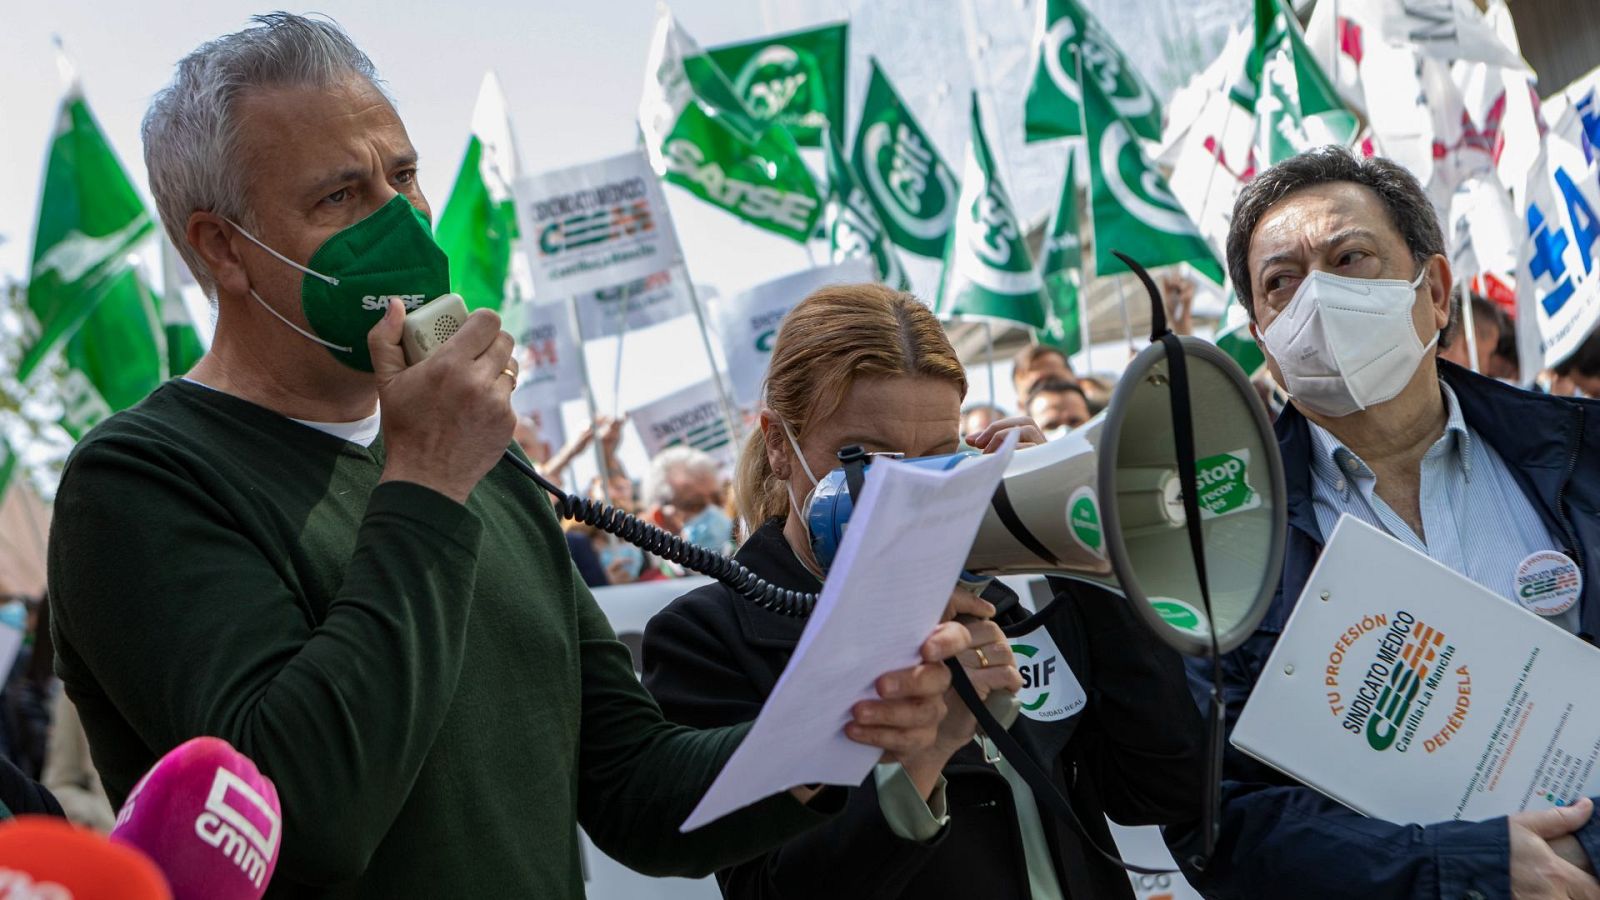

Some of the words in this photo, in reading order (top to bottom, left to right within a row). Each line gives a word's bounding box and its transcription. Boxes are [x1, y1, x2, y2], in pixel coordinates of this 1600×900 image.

[664, 139, 817, 231] SATSE
[1018, 656, 1056, 689] SIF
[1325, 613, 1387, 686] PROFESIÓN
[1342, 662, 1389, 734] SINDICATO
[1376, 610, 1415, 665] MÉDICO
[1366, 621, 1445, 751] CESM
[1327, 692, 1344, 716] TU
[1395, 690, 1434, 752] Castilla-La
[1425, 645, 1456, 690] Mancha
[1423, 664, 1471, 753] DEFIÉNDELA
[1476, 740, 1495, 771] Sindicato
[1502, 706, 1511, 716] de
[1507, 681, 1523, 706] Castilla
[1519, 672, 1527, 682] La
[1523, 646, 1540, 672] Mancha
[195, 812, 267, 888] cmm
